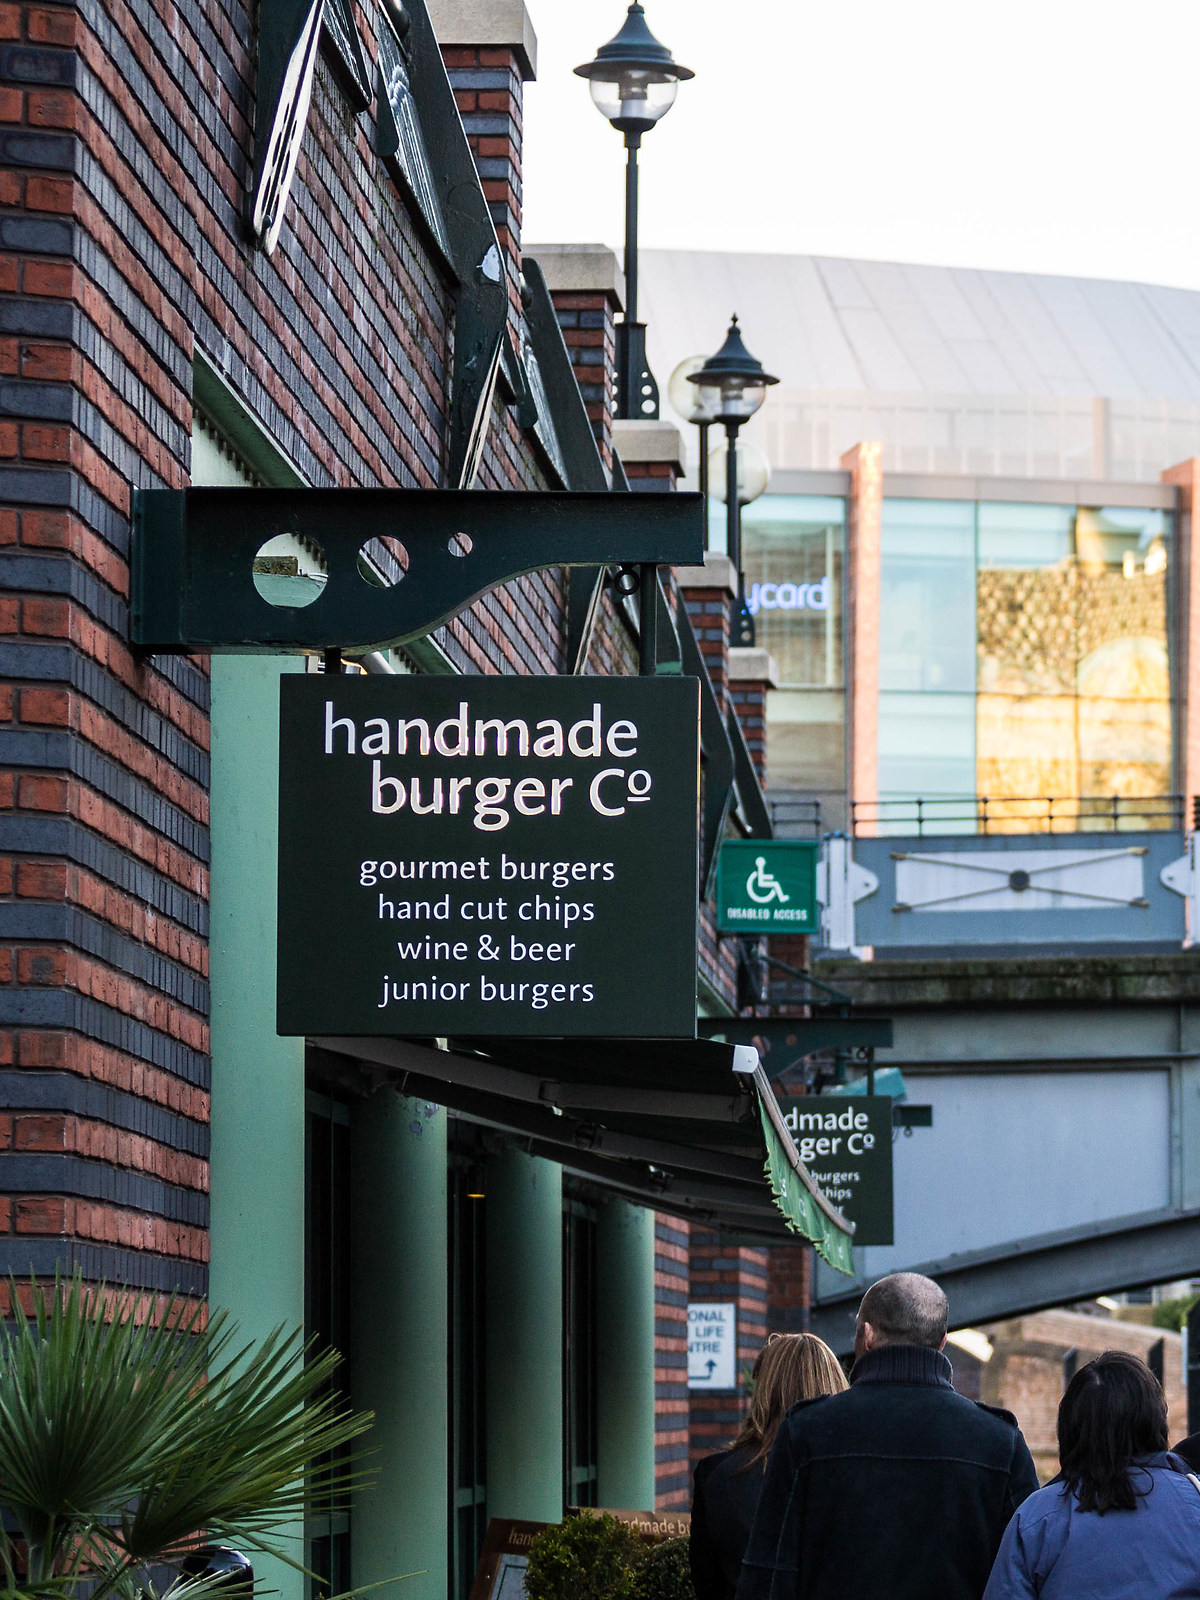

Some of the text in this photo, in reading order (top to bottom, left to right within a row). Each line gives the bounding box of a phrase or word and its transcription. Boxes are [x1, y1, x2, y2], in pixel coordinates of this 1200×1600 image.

[324, 701, 638, 758] handmade
[371, 760, 574, 831] burger
[359, 854, 615, 888] gourmet burgers
[378, 894, 595, 928] hand cut chips
[727, 907, 808, 921] DISABLED ACCESS
[397, 934, 576, 962] wine & beer
[378, 975, 594, 1009] junior burgers
[811, 1169, 860, 1185] burgers
[695, 1325, 724, 1338] LIFE
